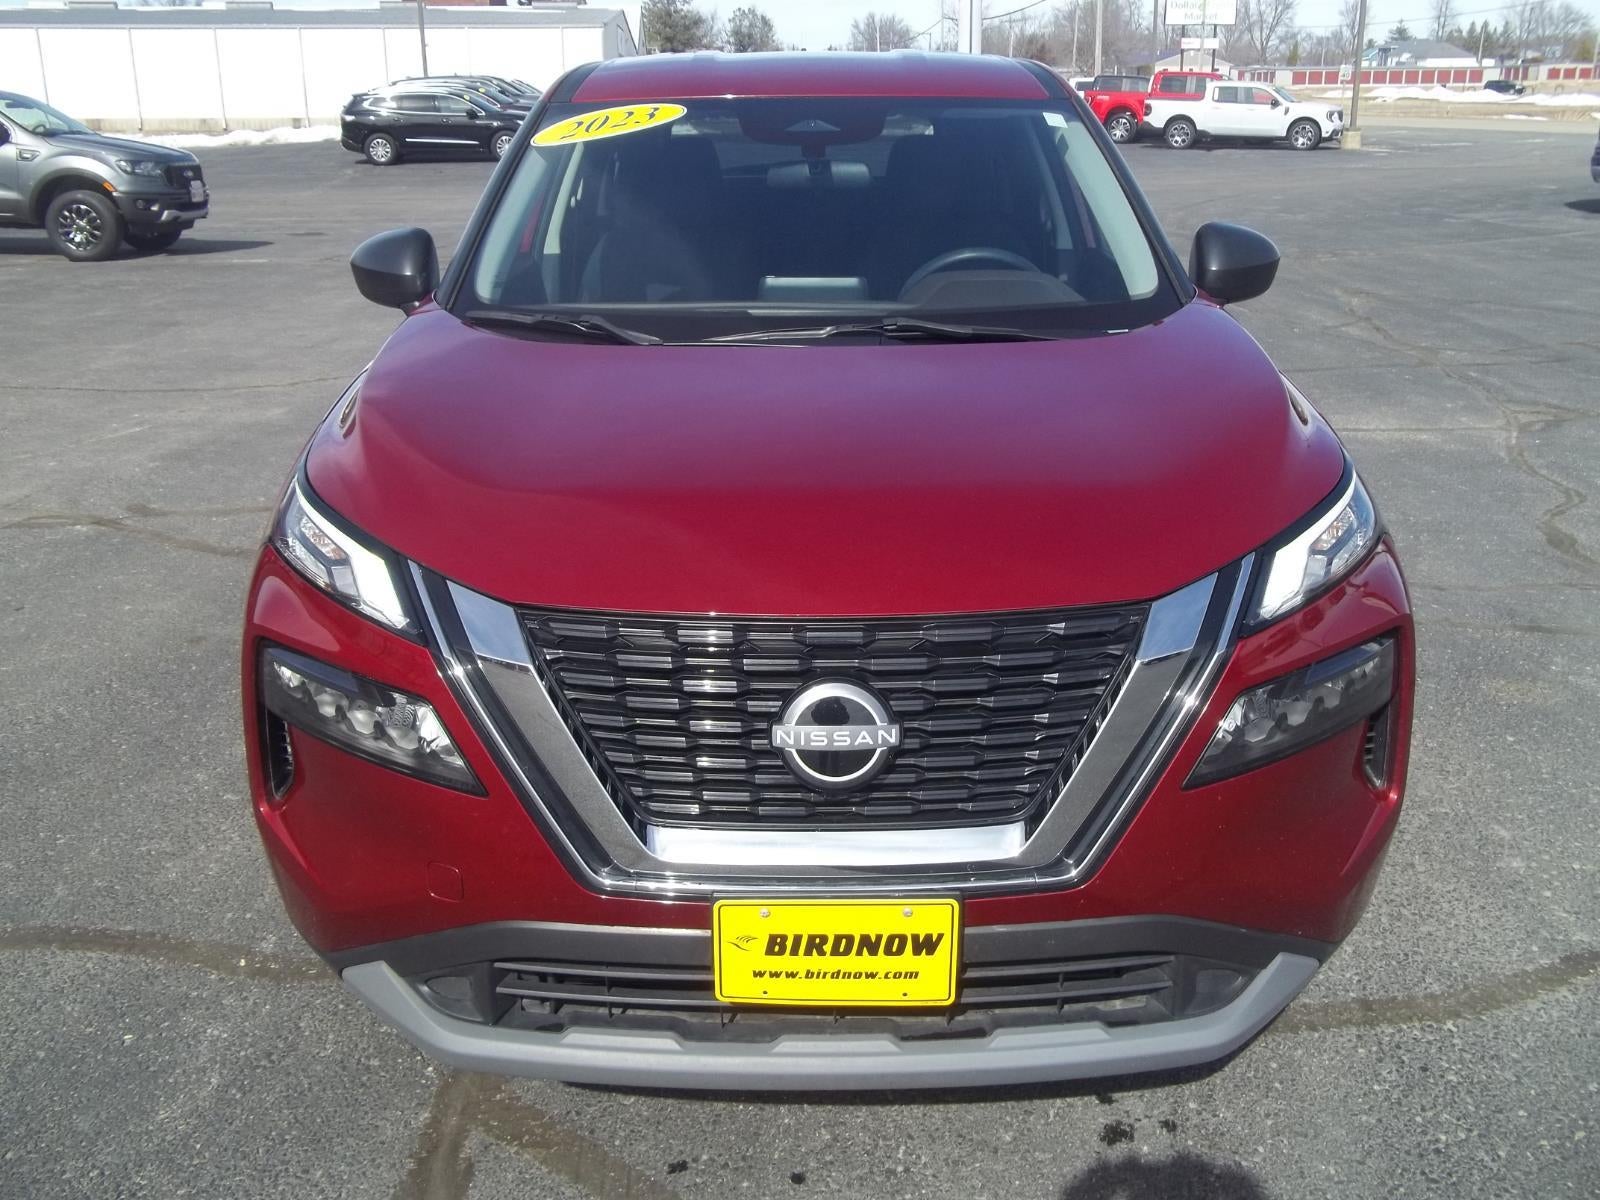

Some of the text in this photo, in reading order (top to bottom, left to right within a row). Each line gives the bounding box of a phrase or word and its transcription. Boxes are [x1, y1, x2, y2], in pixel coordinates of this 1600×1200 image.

[559, 107, 661, 140] 2023
[776, 728, 896, 746] NISSAN
[764, 933, 945, 957] BIRDNOW
[752, 968, 920, 980] www.birdnow.com
